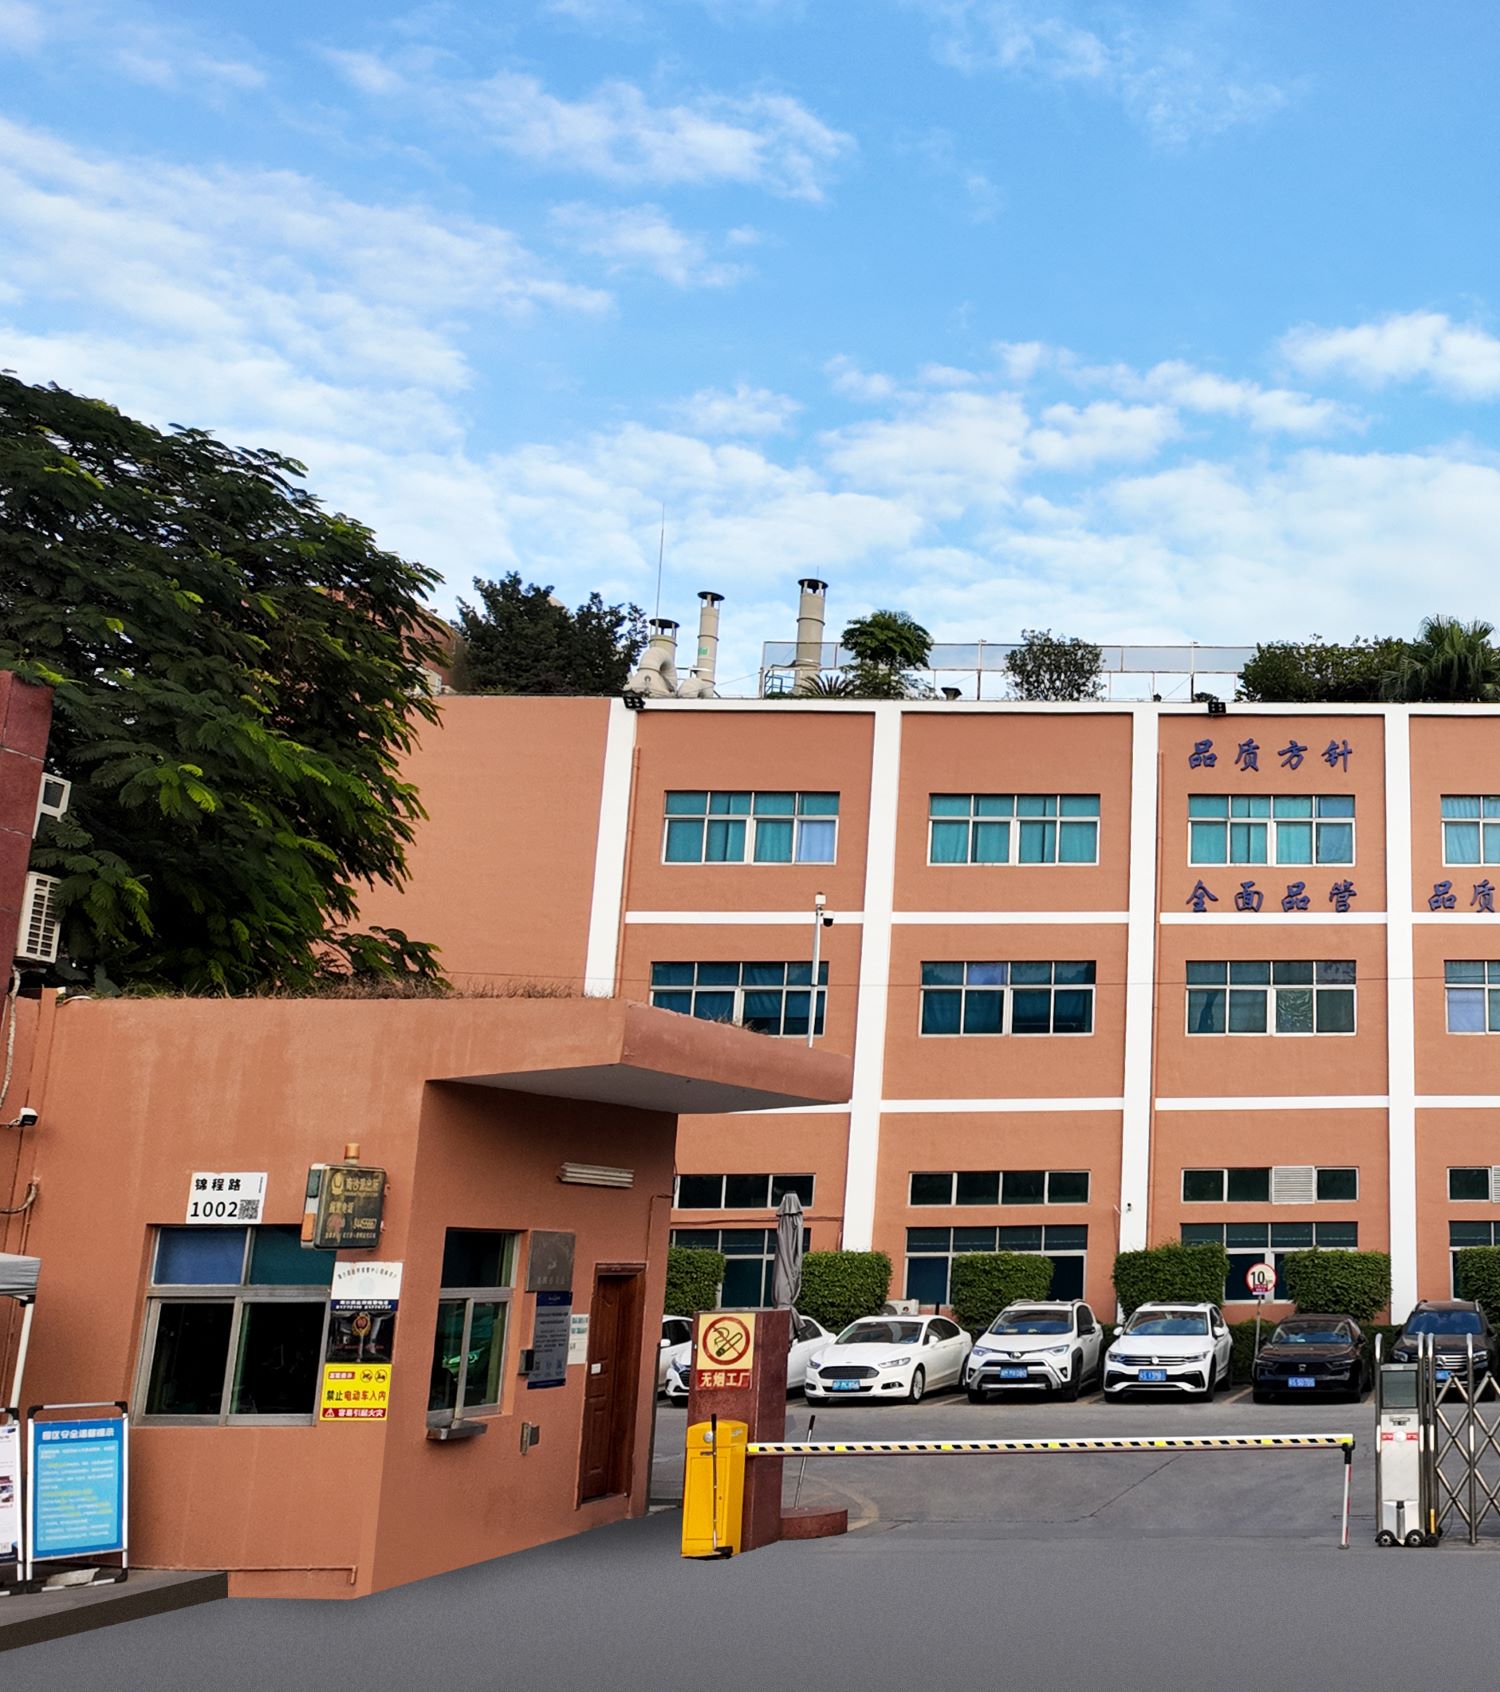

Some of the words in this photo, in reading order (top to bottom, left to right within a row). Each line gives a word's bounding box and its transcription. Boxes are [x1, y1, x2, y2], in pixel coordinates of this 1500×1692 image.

[1188, 738, 1353, 773] 品质方针
[1186, 879, 1357, 913] 全面品管
[195, 1178, 241, 1192] 锦程路
[190, 1201, 238, 1217] 1002
[1250, 1271, 1266, 1286] 10
[700, 1372, 750, 1387] 无烟工厂
